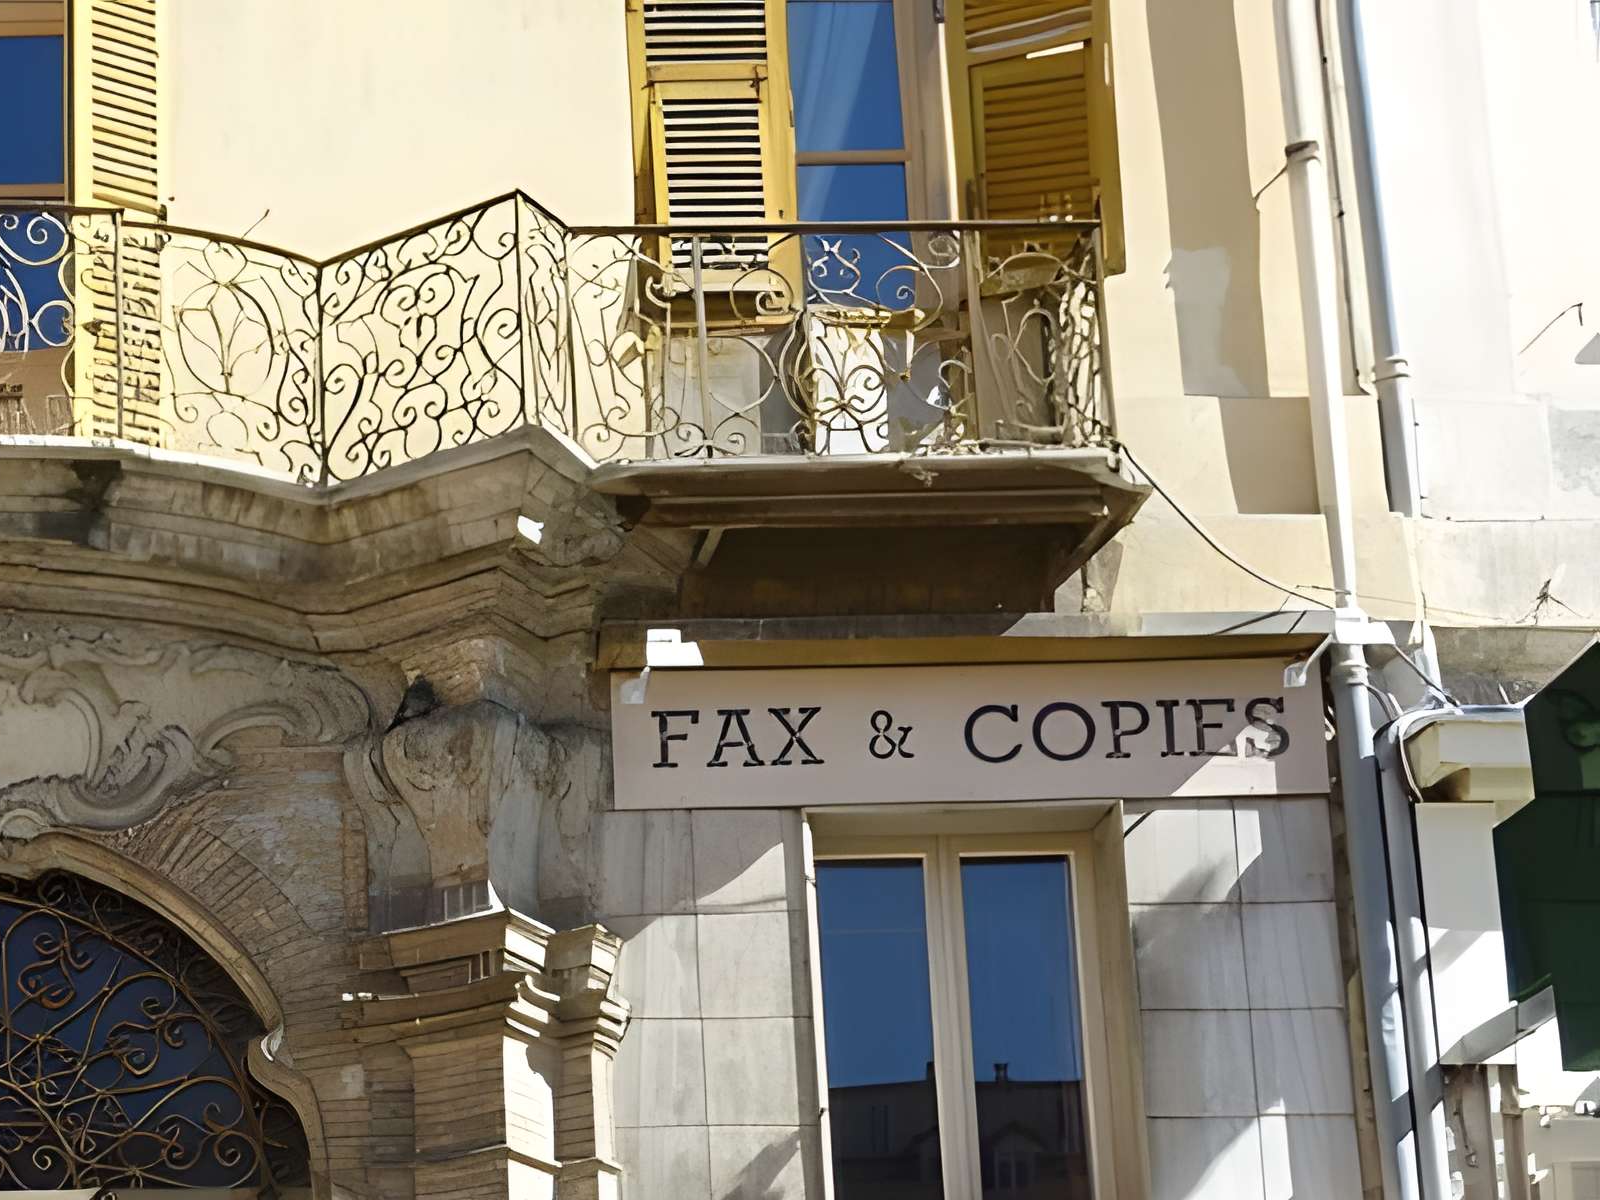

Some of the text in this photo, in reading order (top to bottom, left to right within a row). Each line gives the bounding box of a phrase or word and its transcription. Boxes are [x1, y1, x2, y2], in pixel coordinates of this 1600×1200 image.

[650, 697, 1290, 768] FAX & COPIES
